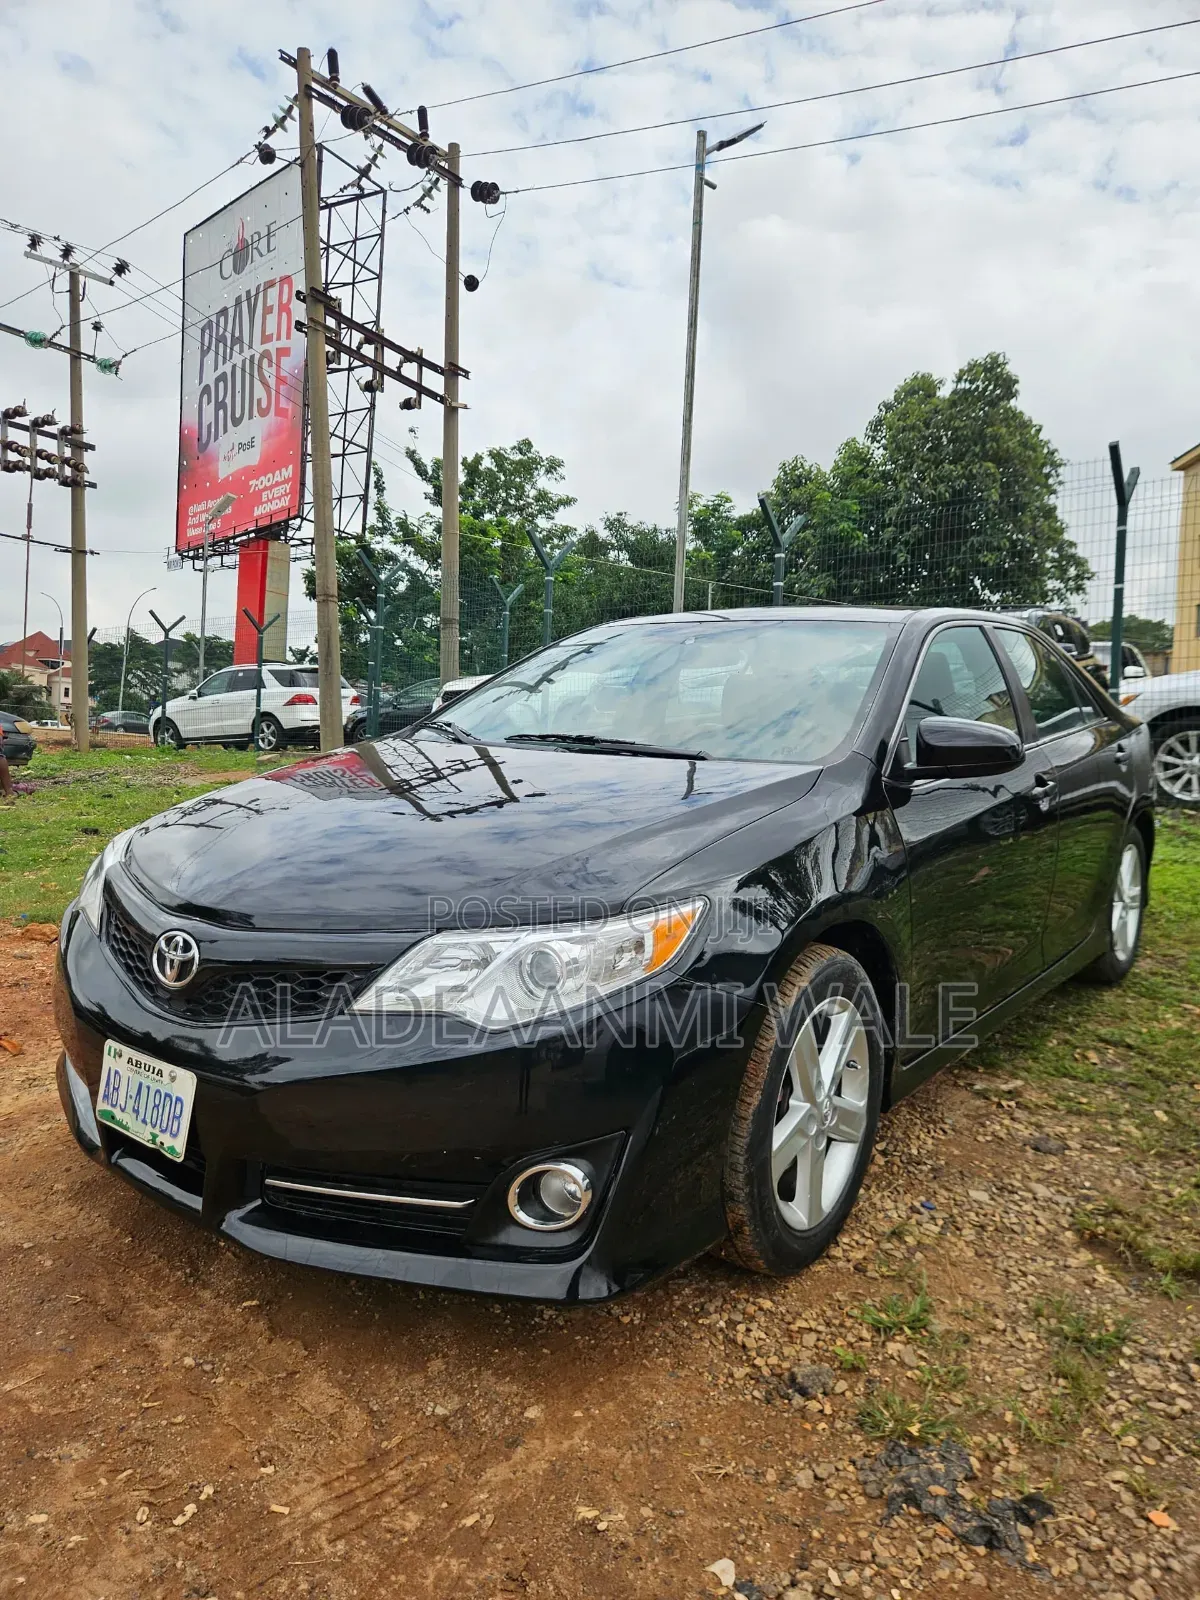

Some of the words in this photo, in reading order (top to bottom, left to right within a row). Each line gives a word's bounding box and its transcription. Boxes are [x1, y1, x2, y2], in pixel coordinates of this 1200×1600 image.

[219, 220, 277, 281] CORE
[199, 275, 293, 386] PRAYER
[197, 347, 291, 454] CRUISE
[249, 464, 293, 493] 7:00AM
[261, 481, 292, 502] EVERY
[253, 494, 291, 516] MONDAY
